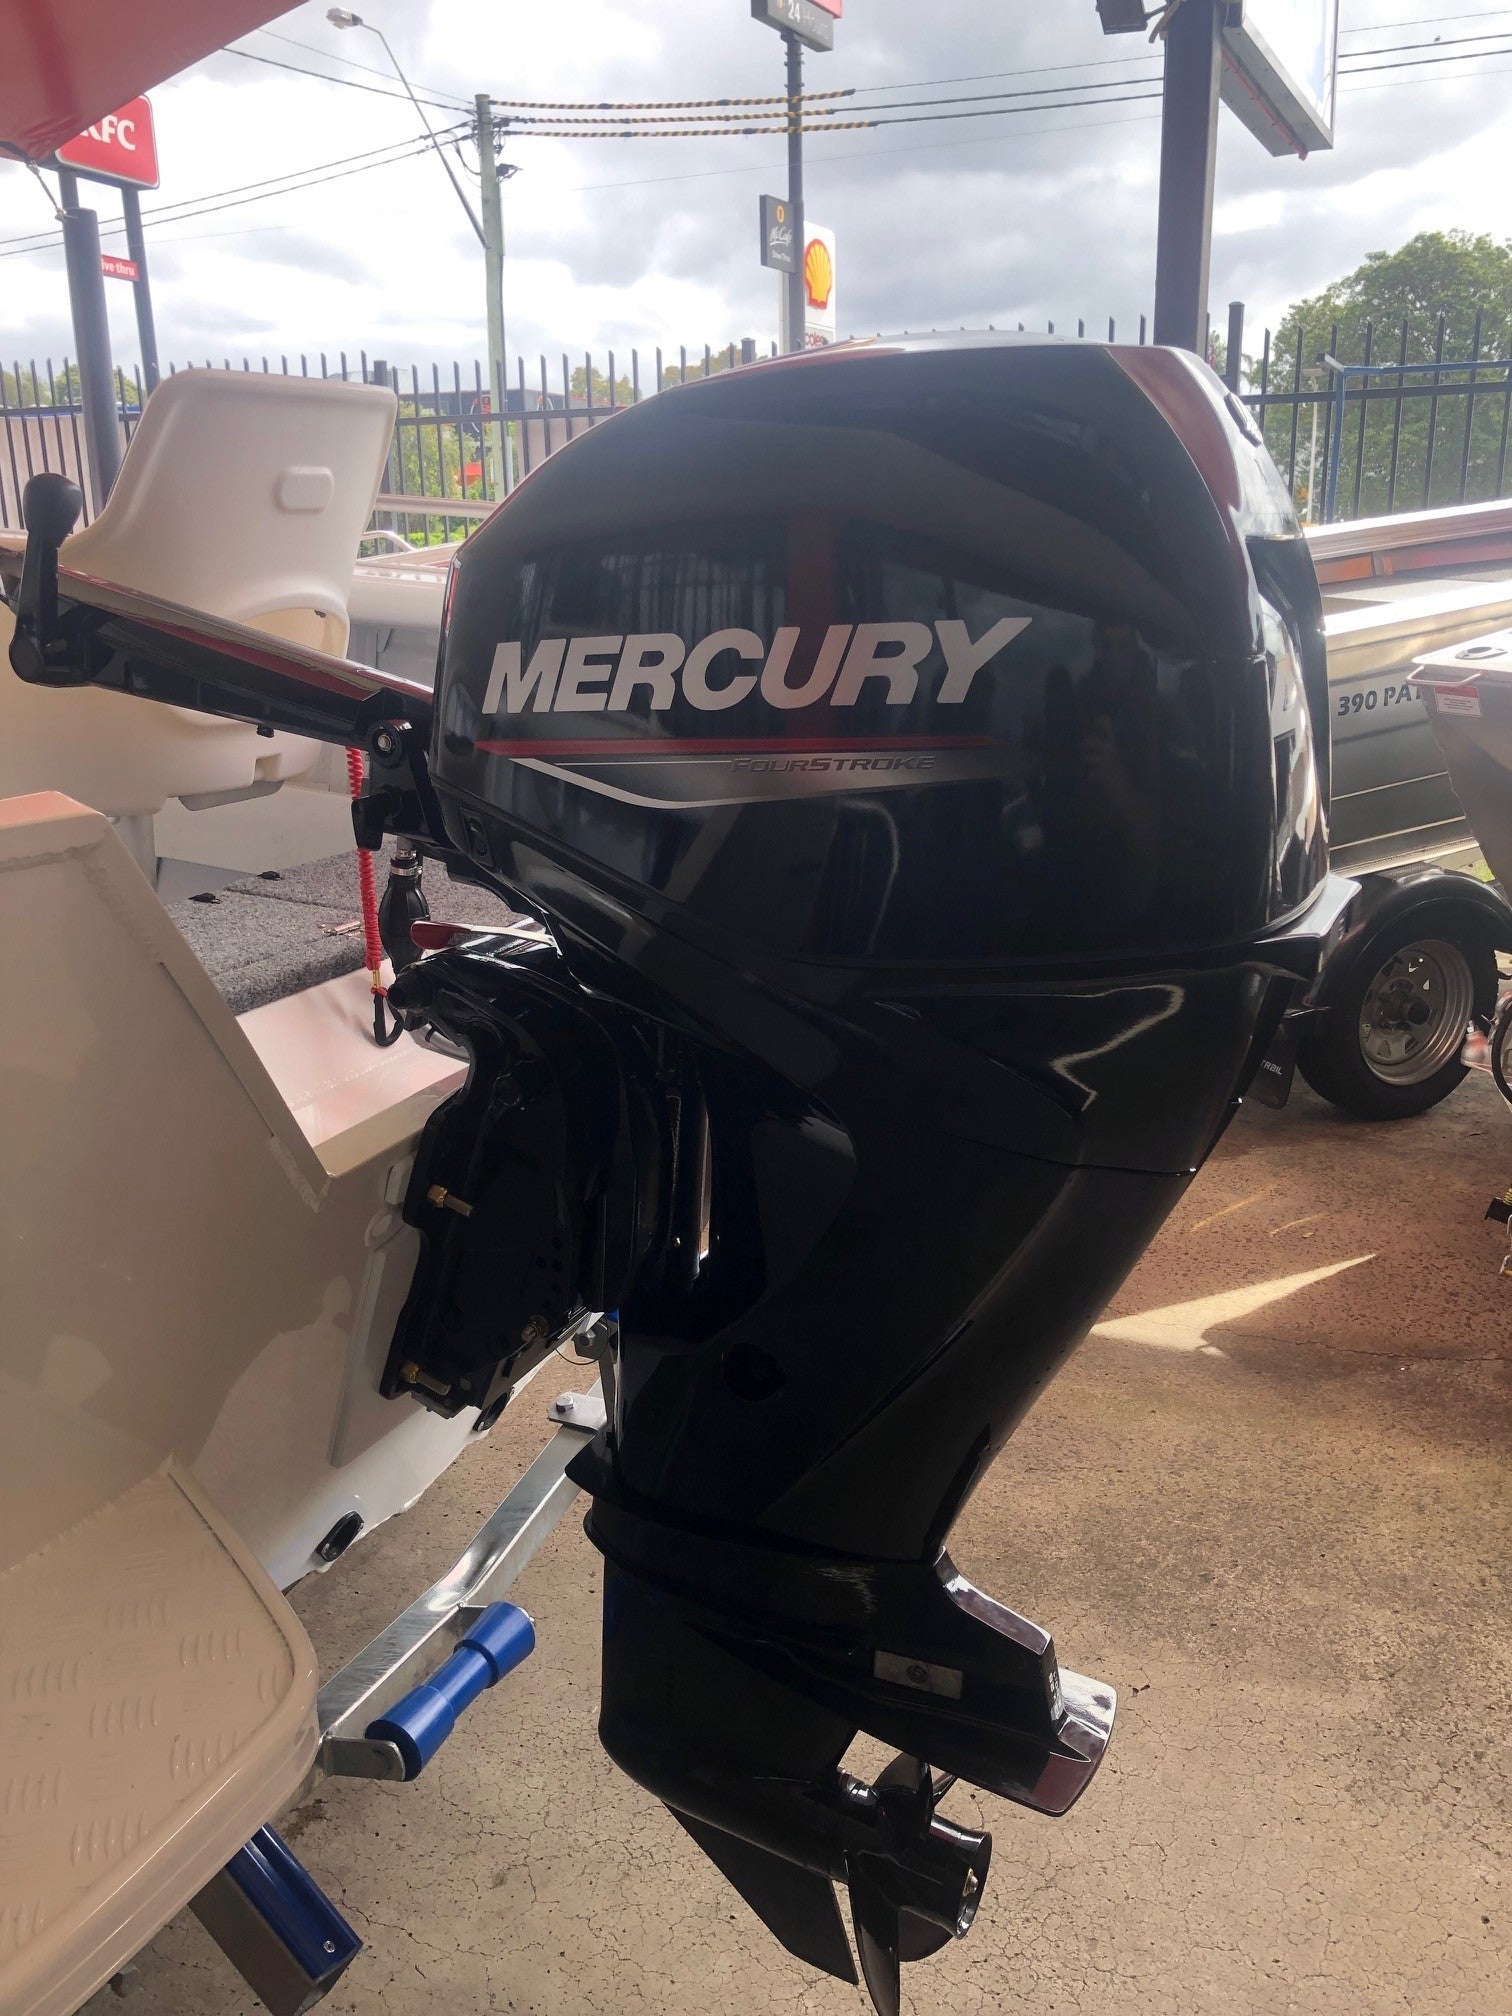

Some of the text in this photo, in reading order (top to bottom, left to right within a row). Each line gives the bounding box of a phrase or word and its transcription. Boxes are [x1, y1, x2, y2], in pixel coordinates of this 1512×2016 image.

[787, 0, 801, 23] 24
[115, 261, 135, 277] thru
[482, 617, 1032, 714] MERCURY
[1337, 690, 1378, 716] 390
